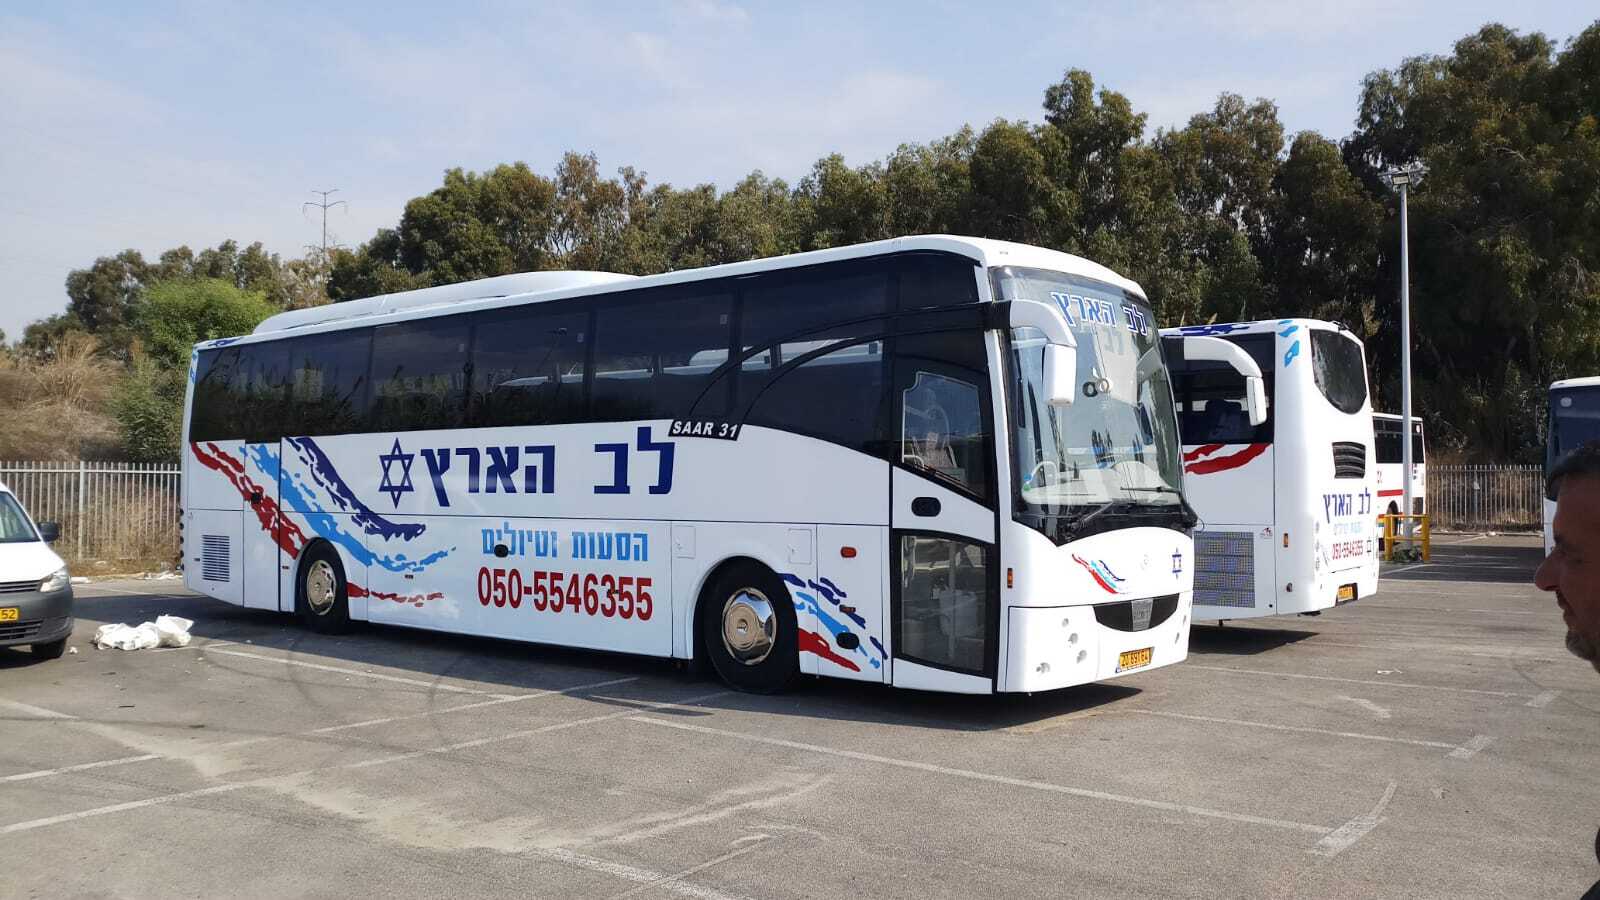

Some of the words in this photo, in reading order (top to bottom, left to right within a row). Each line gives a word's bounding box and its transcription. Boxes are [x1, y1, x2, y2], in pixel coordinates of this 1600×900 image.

[1050, 292, 1117, 328] הארץ
[1121, 304, 1148, 336] לב
[672, 420, 714, 435] SAAR
[718, 423, 738, 438] 31
[420, 445, 556, 507] הארץ
[594, 426, 675, 495] לב
[1322, 493, 1352, 524] הארץ
[1358, 487, 1371, 515] לב
[481, 521, 558, 558] וטיולים
[571, 531, 649, 561] הסעות
[477, 566, 653, 621] 050-5546355
[1, 609, 16, 620] 52
